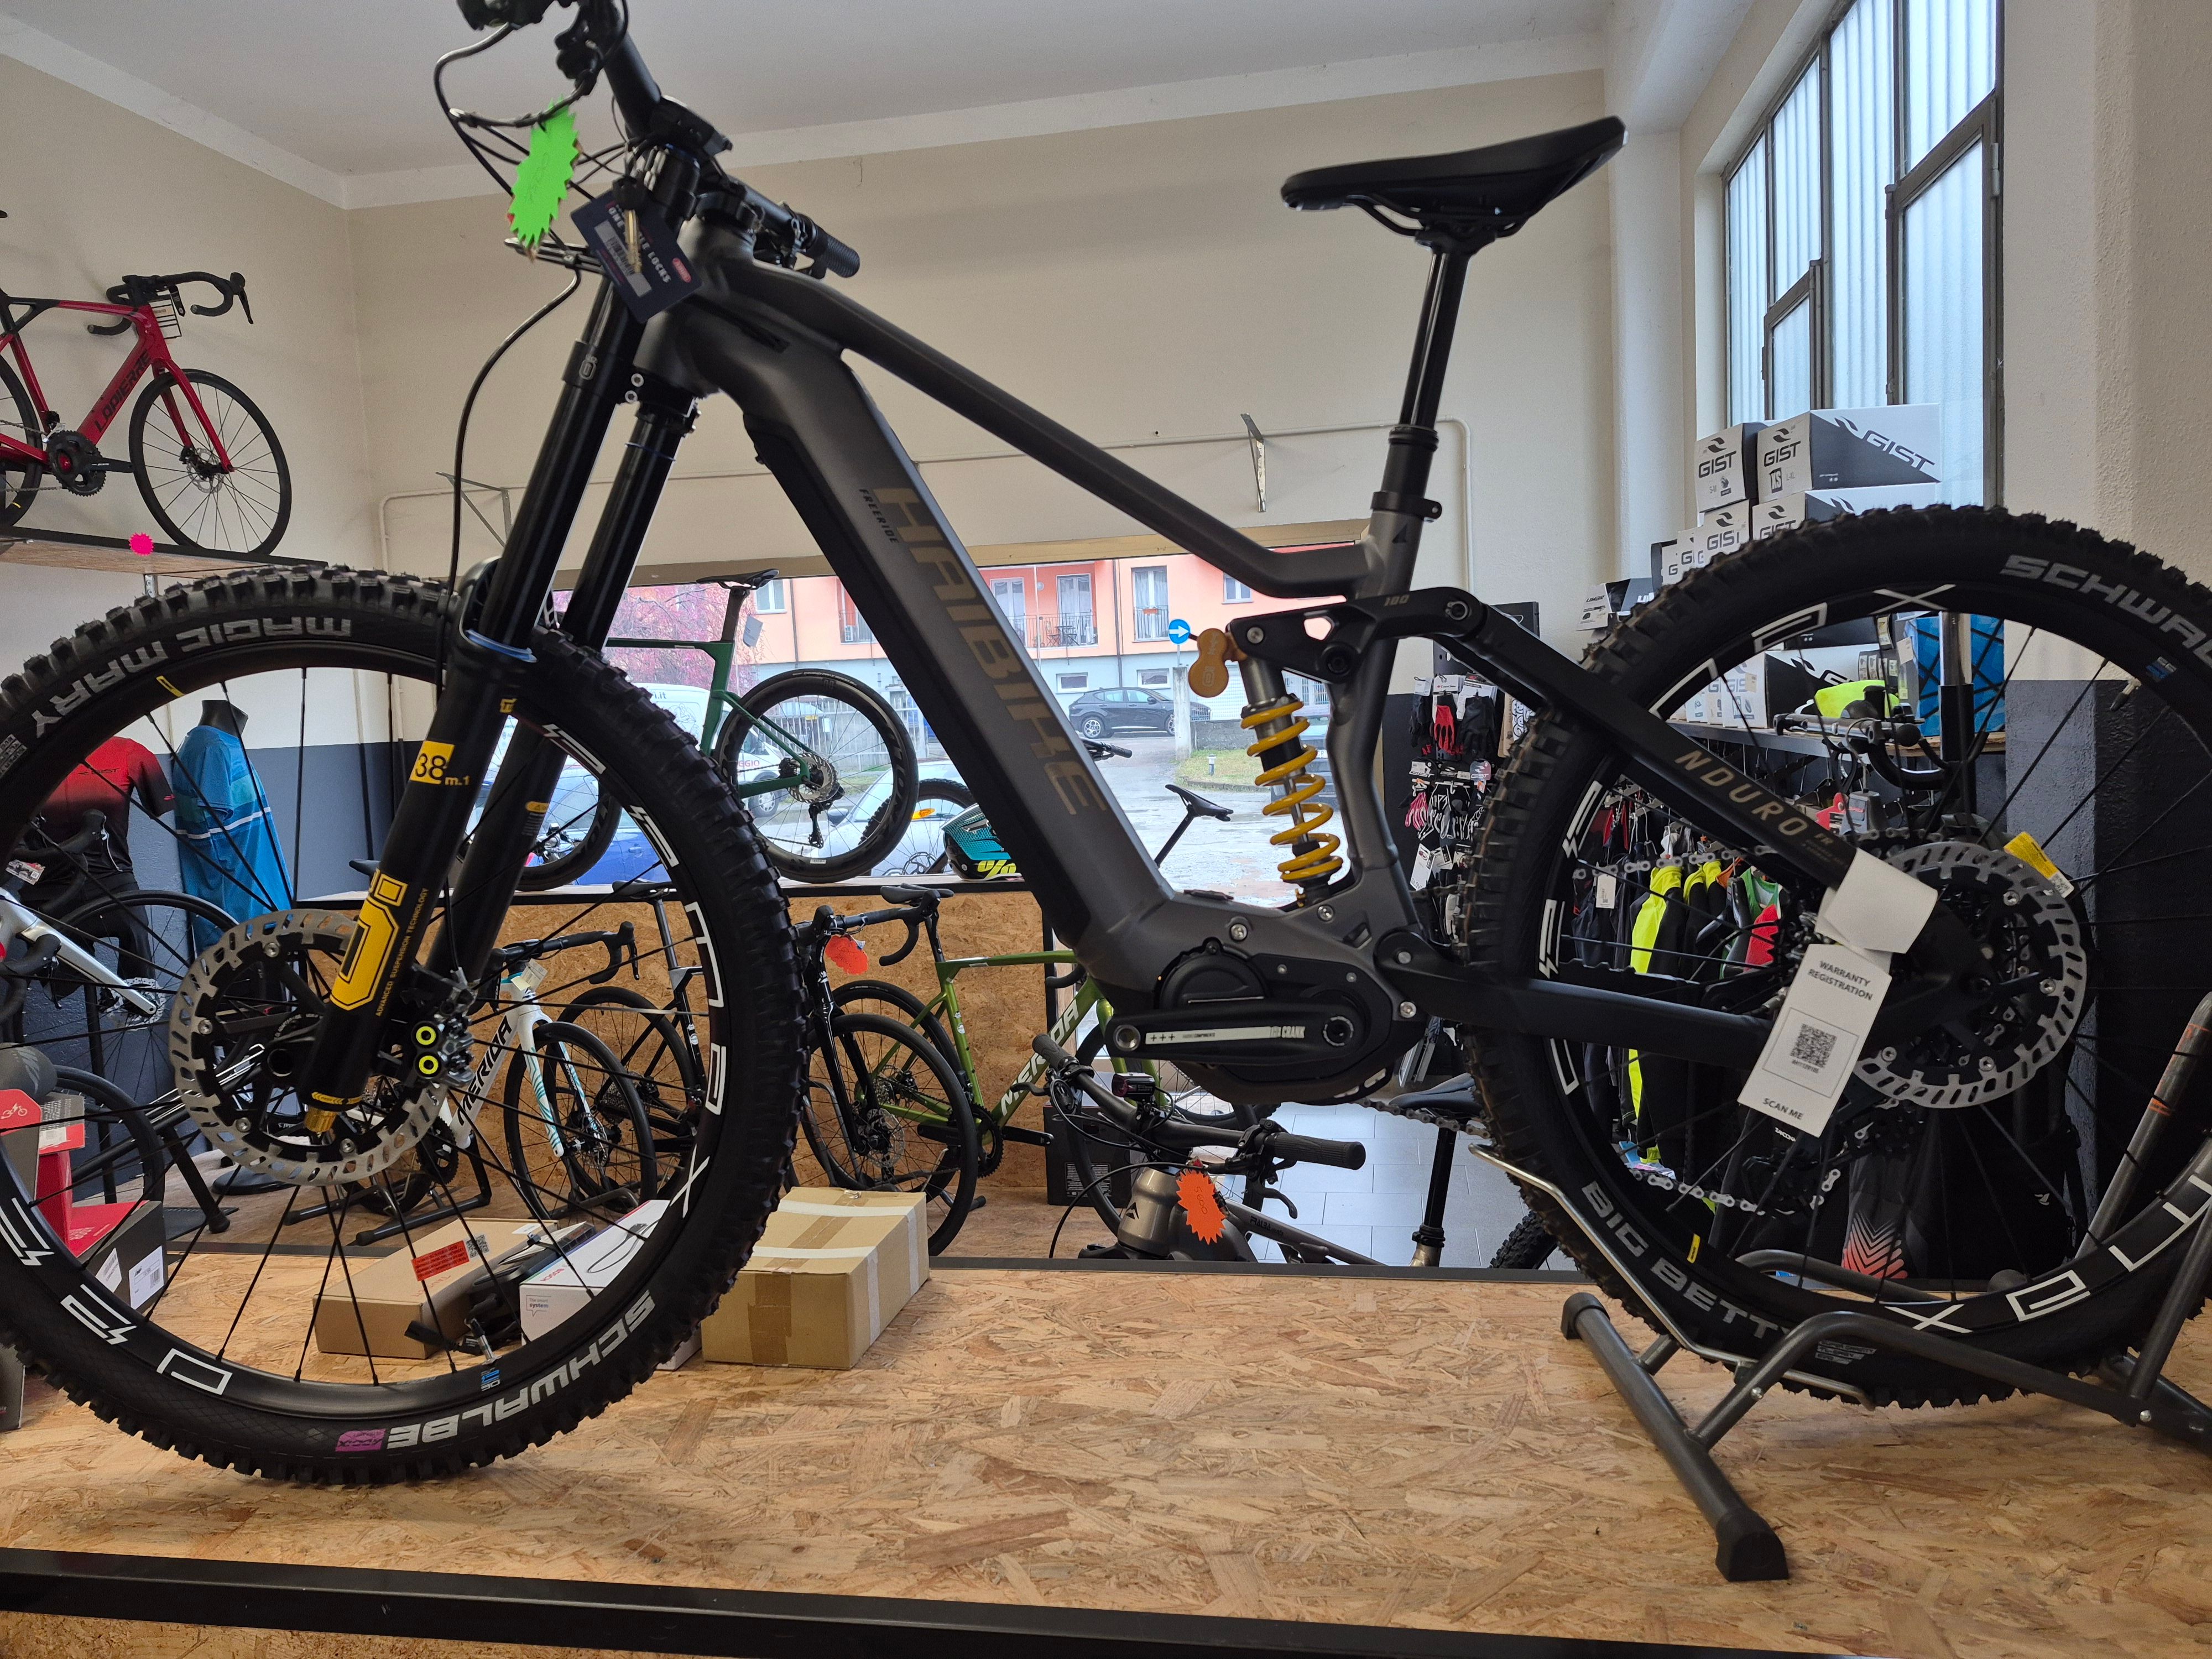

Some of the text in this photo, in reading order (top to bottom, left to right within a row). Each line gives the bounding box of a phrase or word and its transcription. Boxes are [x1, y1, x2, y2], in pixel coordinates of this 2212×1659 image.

[94, 348, 153, 433] LAPIERRE
[1699, 451, 1736, 478] GIST
[1764, 441, 1801, 467] GIST
[1863, 430, 1936, 471] GIST
[1771, 470, 1782, 490] XS
[859, 489, 899, 544] FREERIDE
[2000, 555, 2212, 668] SCHWAL
[873, 487, 1108, 816] HAIBIKE
[31, 616, 353, 738] MAGIC MARY
[1726, 677, 1746, 693] GIS
[415, 753, 470, 786] 38 m.1
[1674, 749, 1808, 836] NDURO
[1411, 877, 1423, 889] GLOV
[375, 887, 429, 1016] ADVANCED SUSPENSION TECHNOLOGY
[1807, 968, 1874, 1001] REGISTRATION
[1819, 960, 1871, 987] WARRANTY
[1281, 1025, 1306, 1039] CRANK
[457, 1014, 513, 1126] MERIDA
[1000, 998, 1080, 1116] MERDA
[1762, 1097, 1804, 1121] SCAN ME
[1194, 1186, 1209, 1215] 5600
[1582, 1181, 1790, 1340] BIG BETT
[387, 1289, 655, 1449] SCHWALBE
